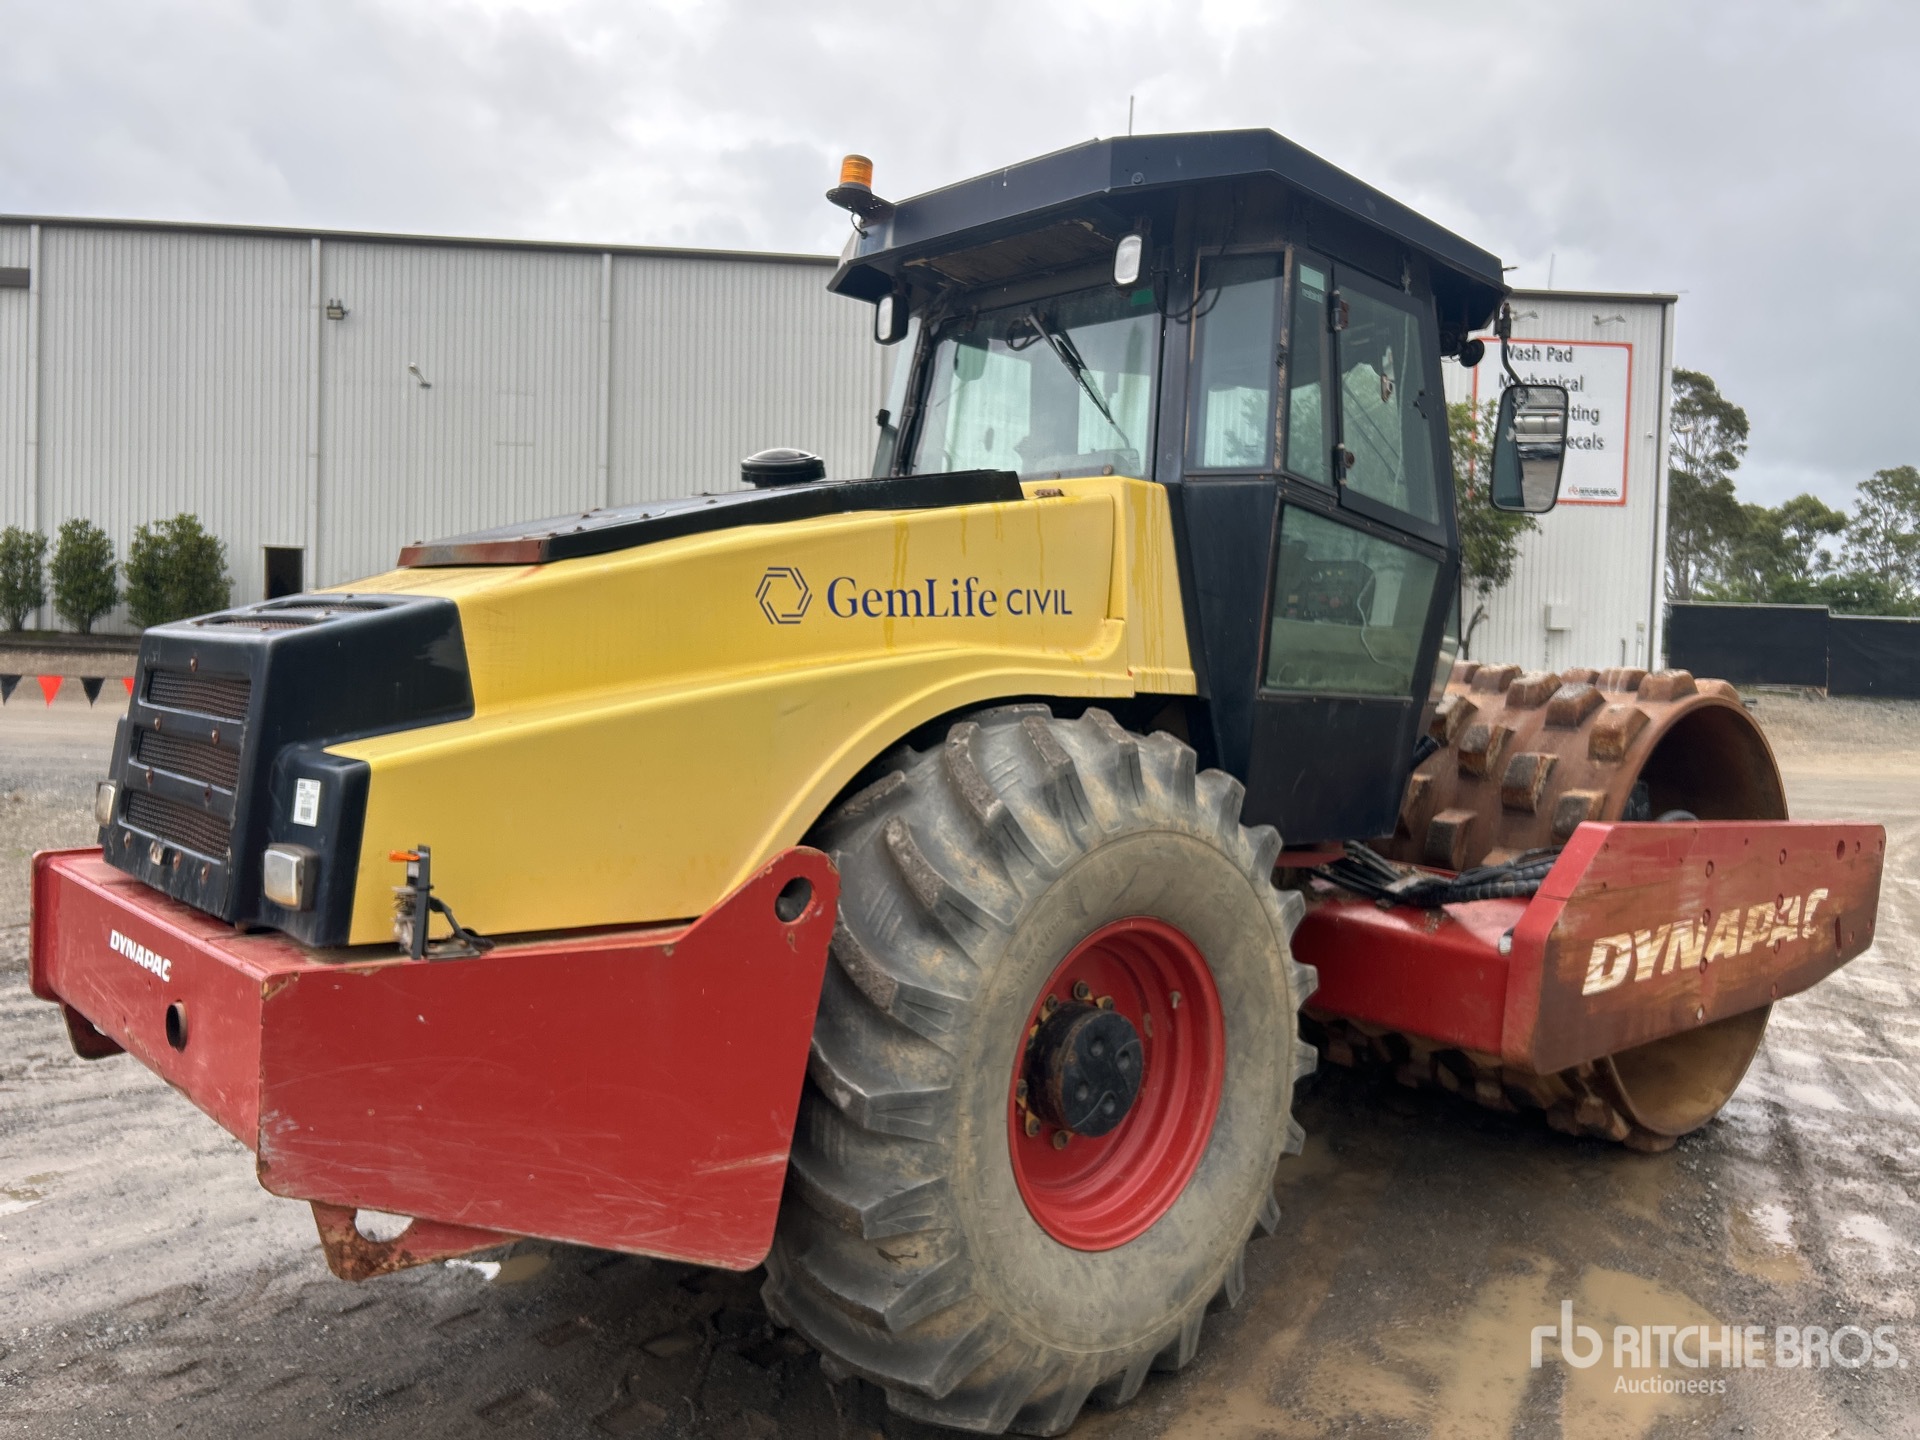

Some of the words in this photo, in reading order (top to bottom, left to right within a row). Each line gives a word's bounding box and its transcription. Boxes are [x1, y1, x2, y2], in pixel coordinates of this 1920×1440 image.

[1547, 345, 1573, 362] Pad
[1500, 373, 1584, 392] Mchanical
[1566, 432, 1605, 450] ecals
[827, 577, 997, 618] GemLife
[1006, 589, 1072, 615] CIVIL
[110, 929, 172, 983] DYNAPAC
[1582, 888, 1828, 996] DYNAPAC
